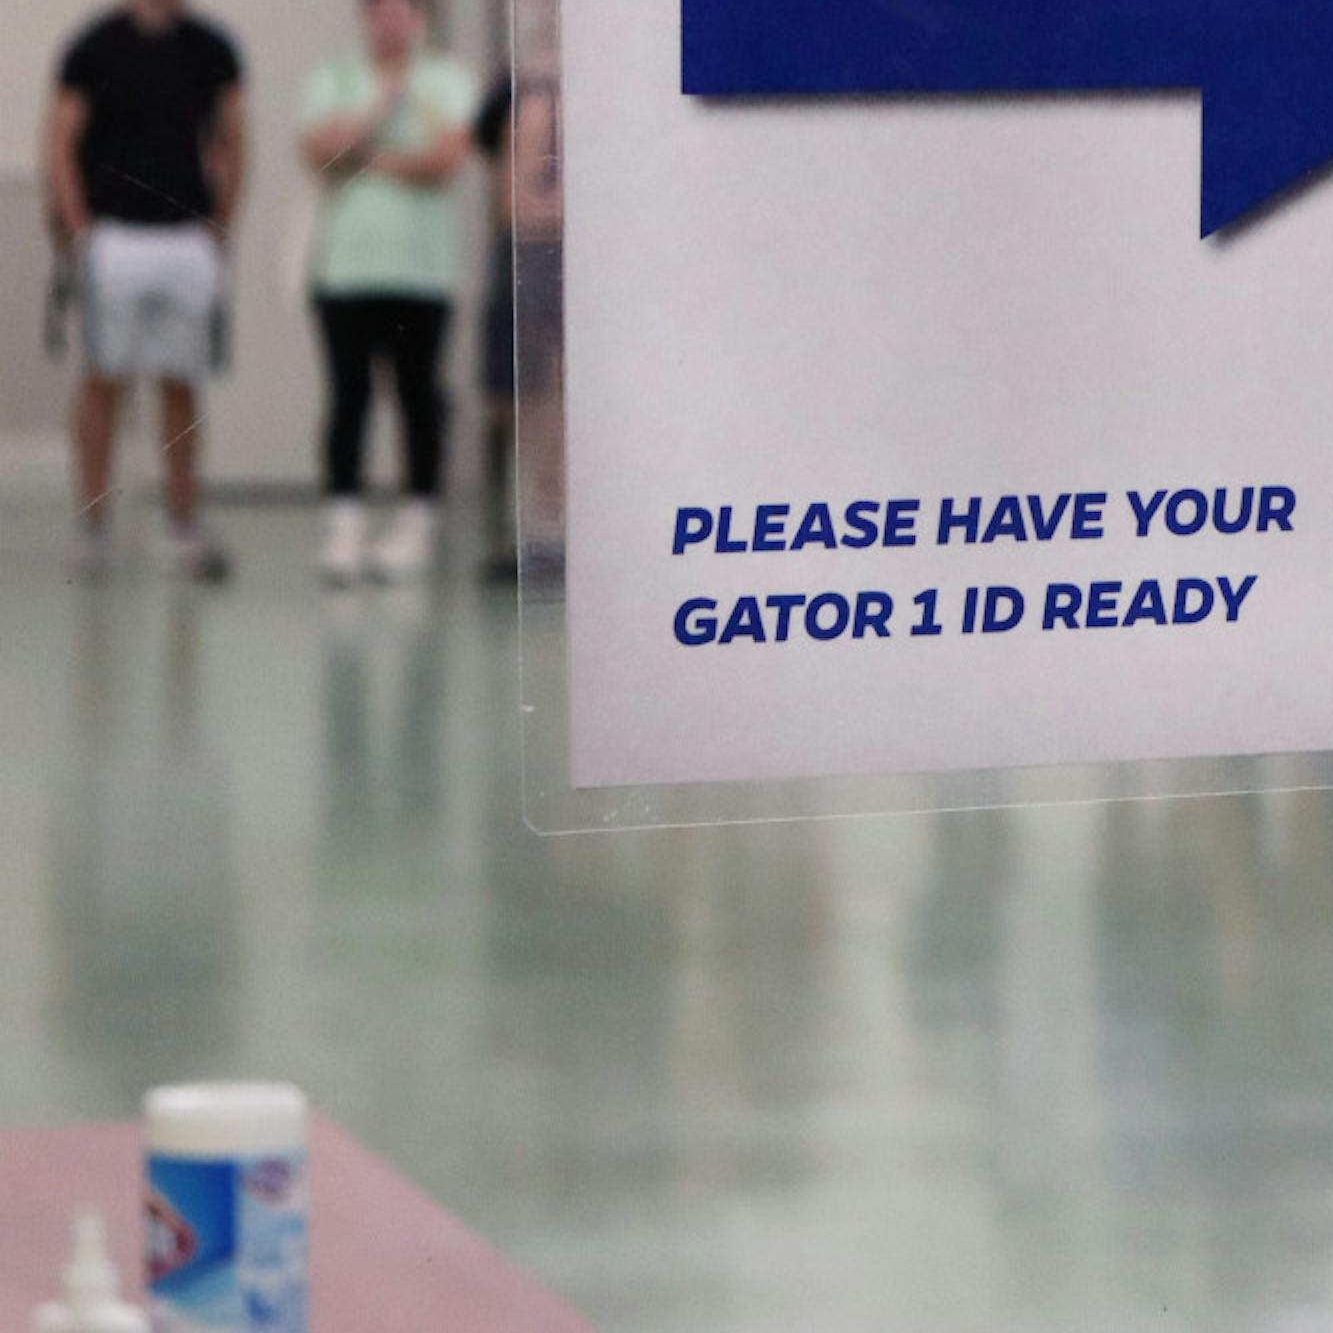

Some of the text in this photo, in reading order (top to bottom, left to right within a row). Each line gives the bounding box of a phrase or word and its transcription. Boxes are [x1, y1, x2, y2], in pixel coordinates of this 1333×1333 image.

[671, 484, 1297, 555] PLEASE HAVE YOUR
[671, 574, 1259, 646] GATOR 1 ID READY
